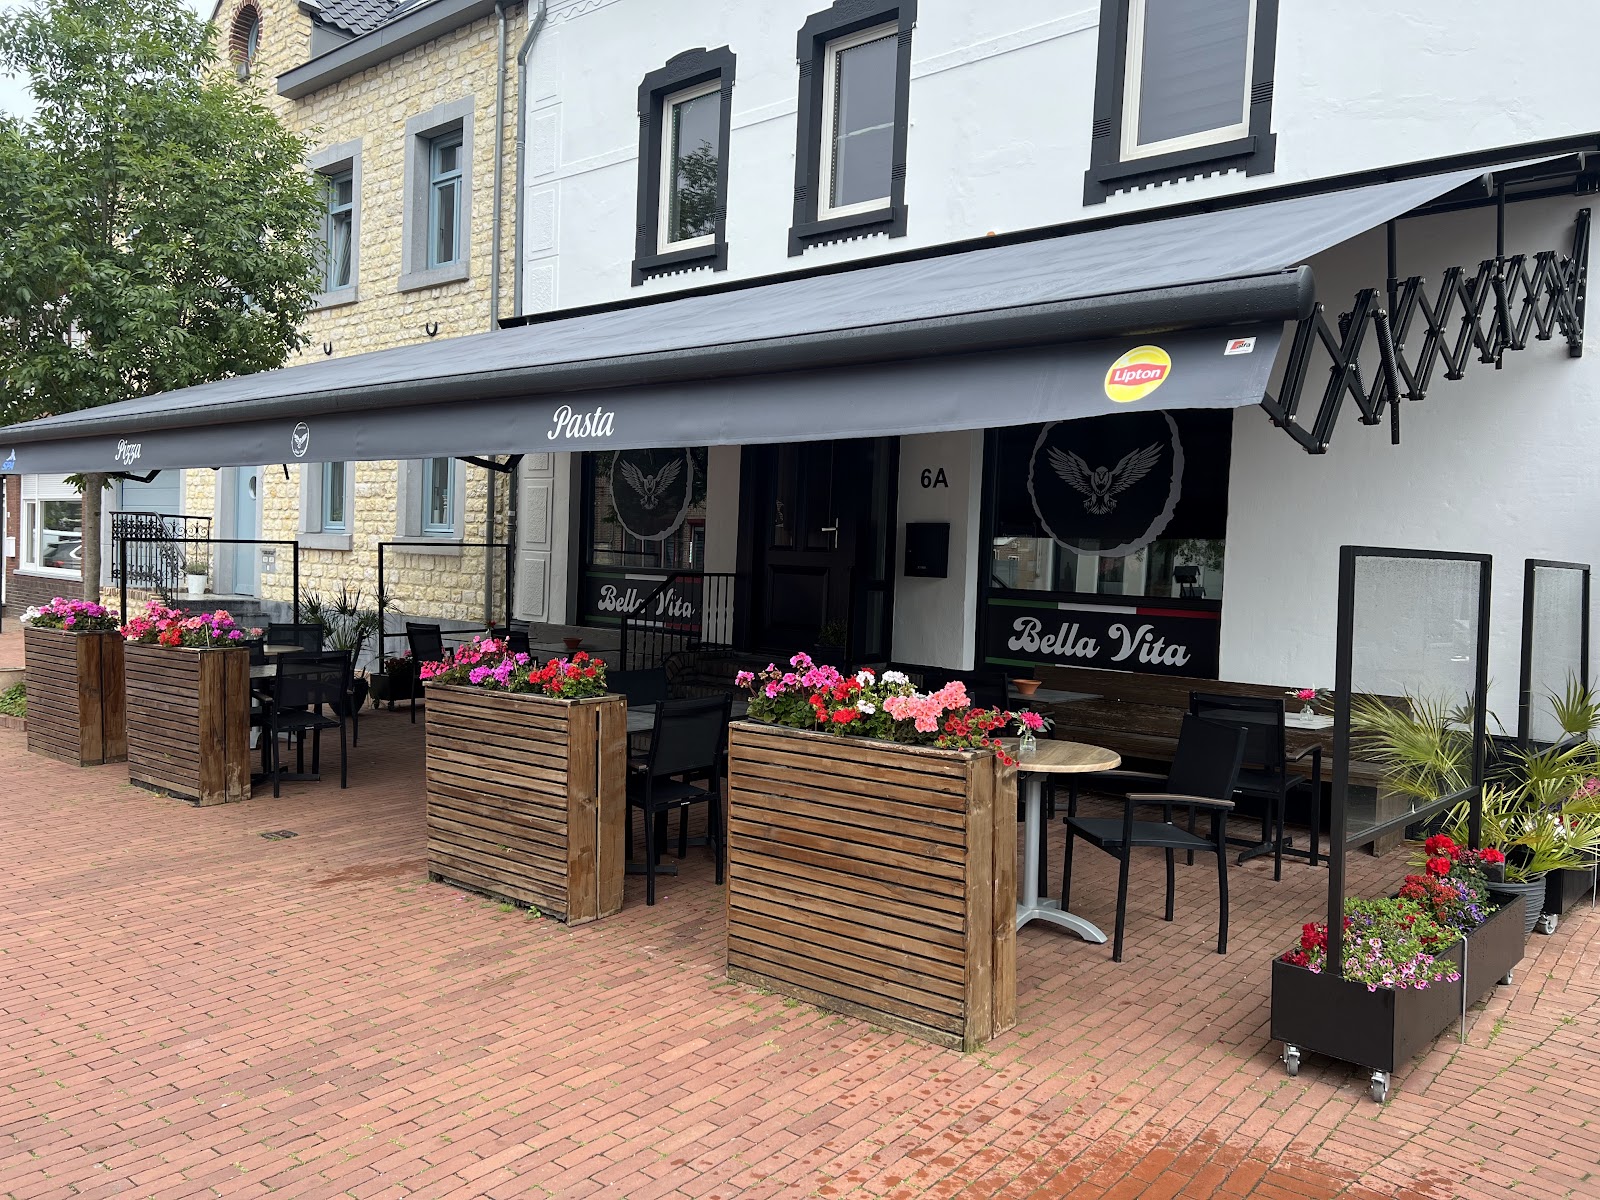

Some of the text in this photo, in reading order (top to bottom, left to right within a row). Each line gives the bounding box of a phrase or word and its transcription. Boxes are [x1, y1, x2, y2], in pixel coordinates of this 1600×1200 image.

[1113, 366, 1162, 383] Lipton
[547, 405, 615, 440] Pasta
[114, 438, 142, 466] Pizza
[920, 467, 949, 489] 6A
[1007, 616, 1192, 667] Bella Vita
